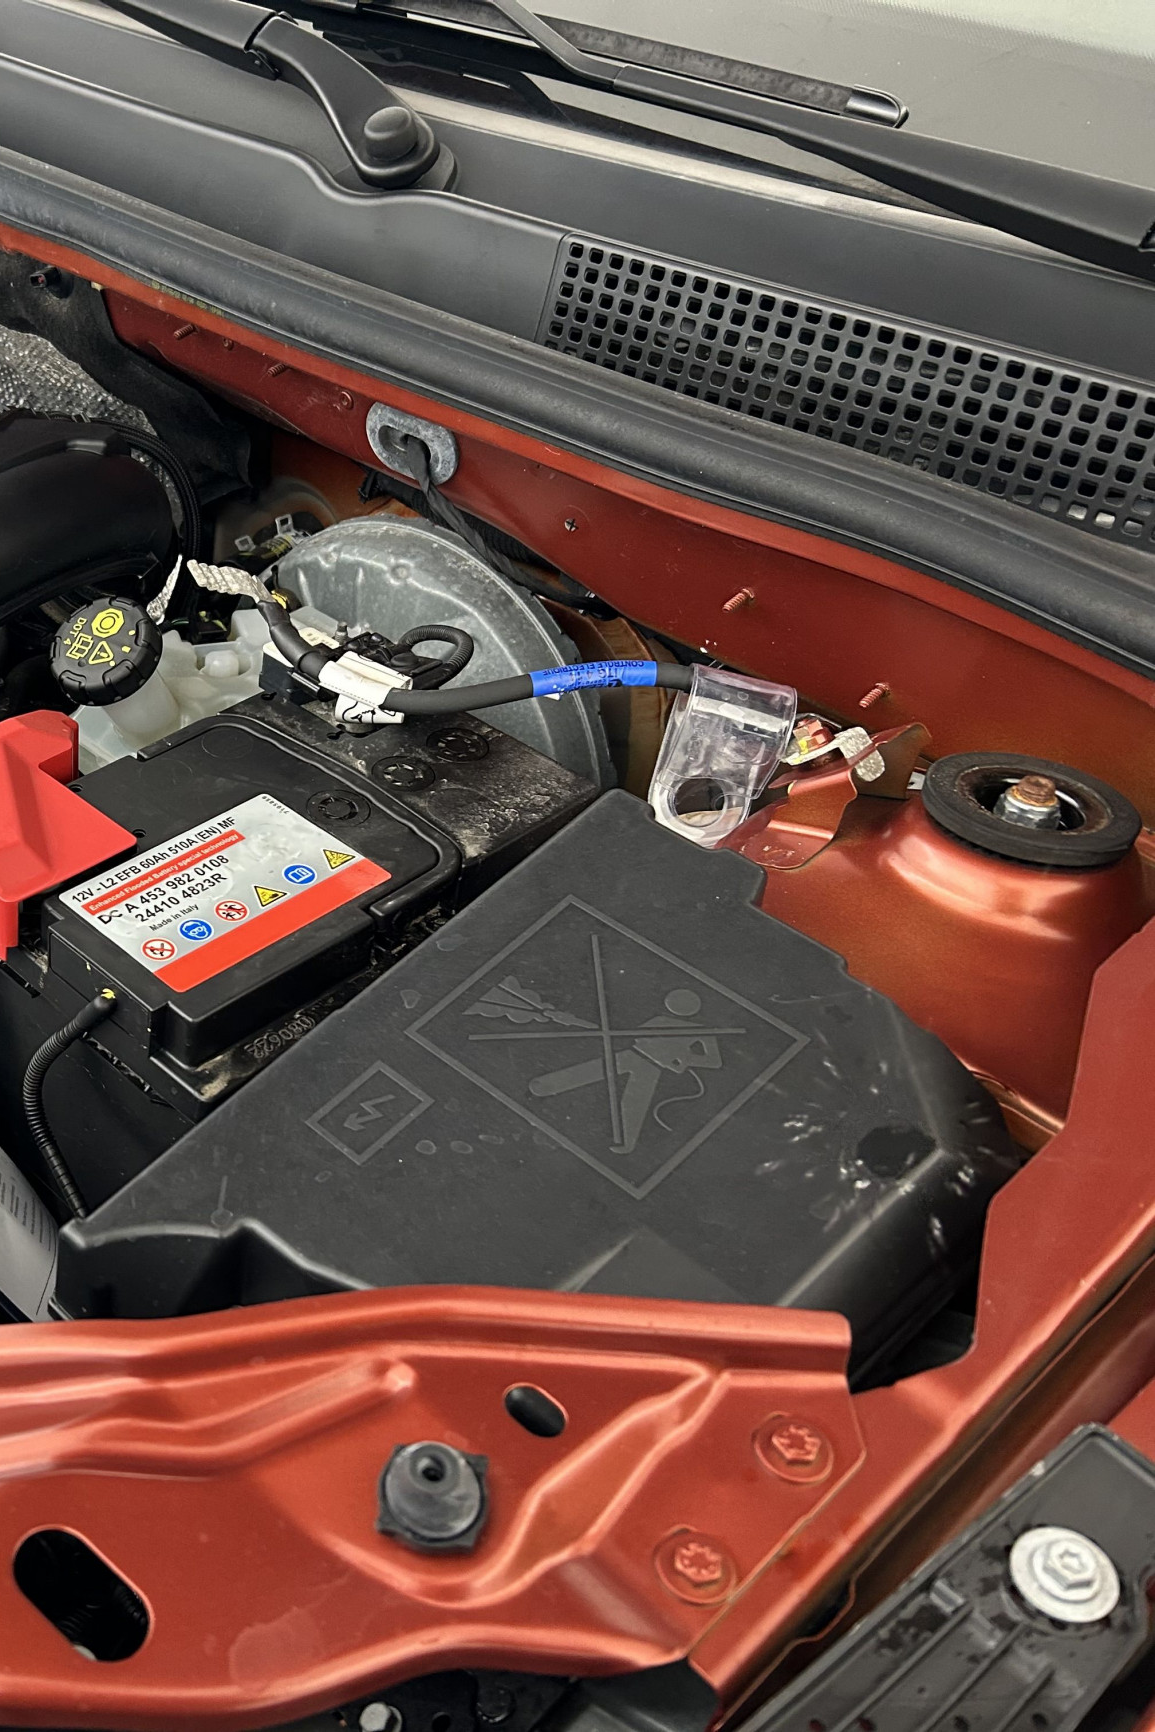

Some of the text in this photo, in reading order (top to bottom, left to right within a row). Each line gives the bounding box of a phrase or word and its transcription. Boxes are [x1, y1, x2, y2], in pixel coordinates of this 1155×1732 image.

[63, 617, 87, 645] DOT 4
[72, 887, 95, 903] 12V
[99, 877, 119, 890] L2
[114, 865, 142, 882] EFB
[139, 850, 169, 870] 60Ah
[167, 838, 198, 855] 510A
[196, 825, 222, 842] (EN)
[220, 816, 237, 830] MF
[88, 833, 240, 912] Enhanced Flooded Battery special technology
[124, 902, 140, 914] A
[139, 887, 167, 905] 453
[165, 872, 195, 890] 982
[194, 855, 230, 877] 0108
[135, 872, 228, 922] 24410 4823R
[149, 903, 199, 932] Made in Italy
